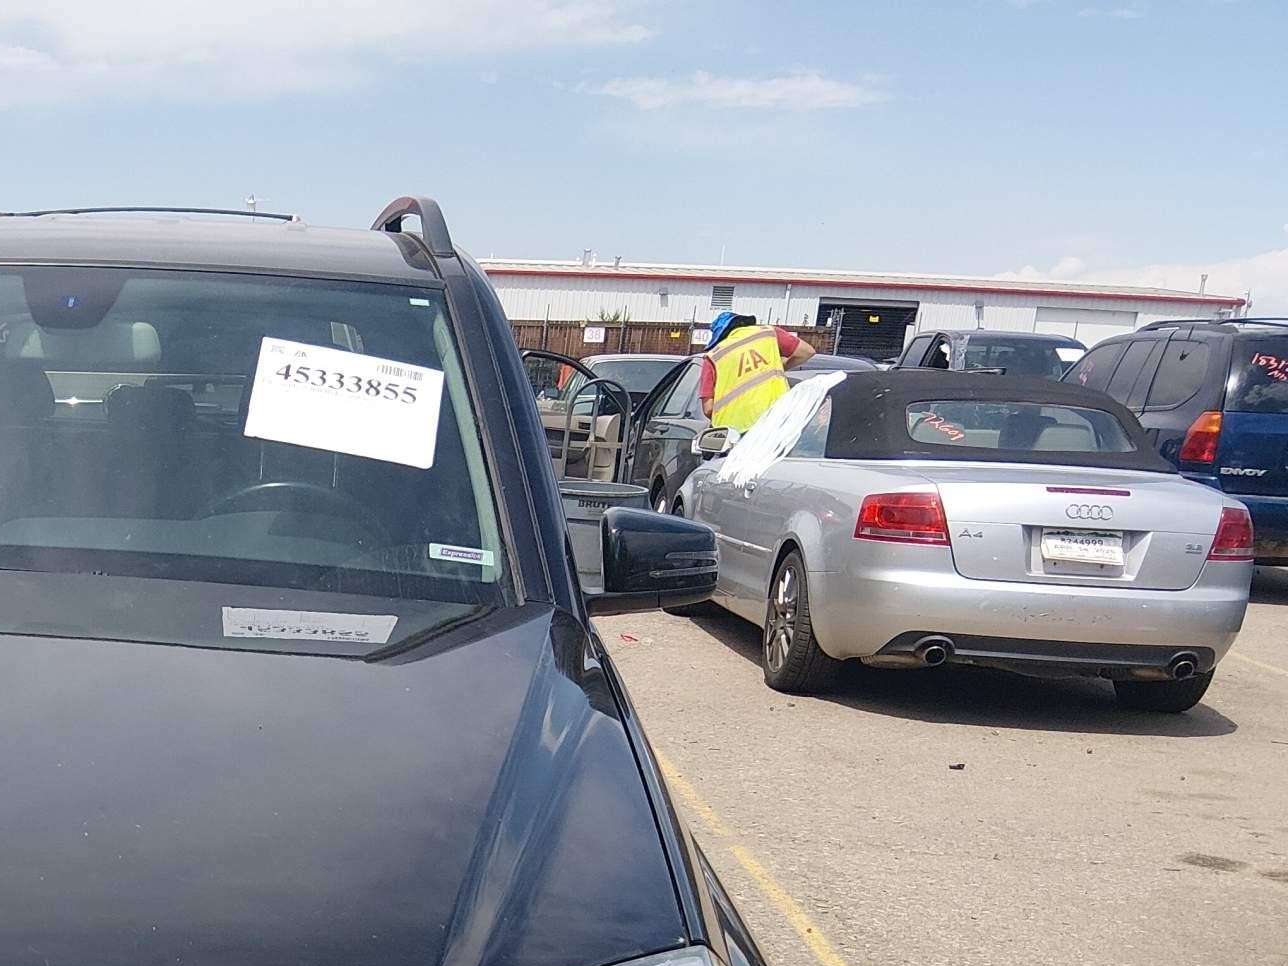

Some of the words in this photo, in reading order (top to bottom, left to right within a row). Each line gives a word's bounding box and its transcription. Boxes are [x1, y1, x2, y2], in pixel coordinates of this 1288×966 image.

[275, 363, 418, 406] 45333855
[1219, 467, 1267, 477] ENVOY
[958, 528, 984, 538] A4
